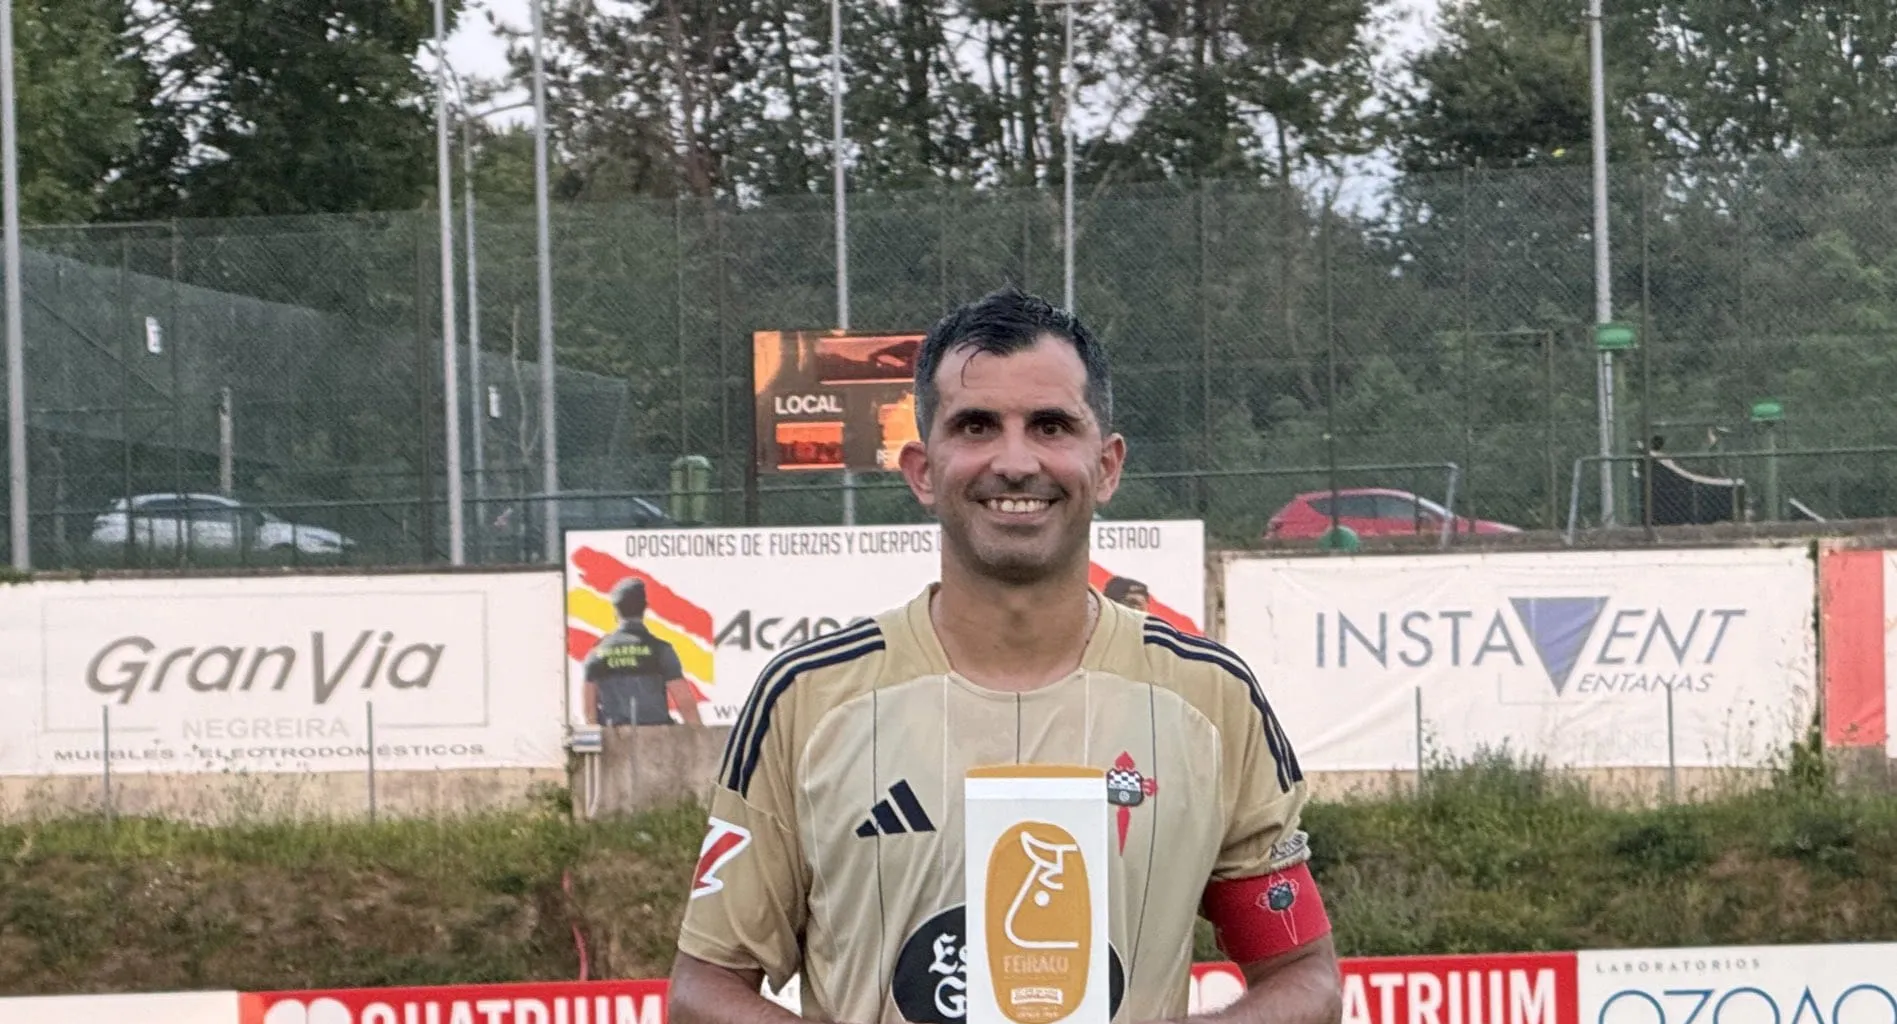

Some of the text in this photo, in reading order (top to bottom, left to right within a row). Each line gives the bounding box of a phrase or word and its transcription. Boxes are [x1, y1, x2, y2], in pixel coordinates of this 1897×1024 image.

[774, 394, 843, 415] LOCAL
[625, 535, 736, 558] OPOSICIONES
[741, 533, 762, 556] DE
[769, 532, 841, 556] FUERZAS
[846, 532, 856, 555] Y
[859, 530, 932, 554] CUERPOS
[1097, 526, 1160, 549] ESTADO
[182, 718, 349, 740] NEGREIRA
[54, 749, 174, 761] MUEBLES
[1596, 958, 1761, 974] LABORATORIOS
